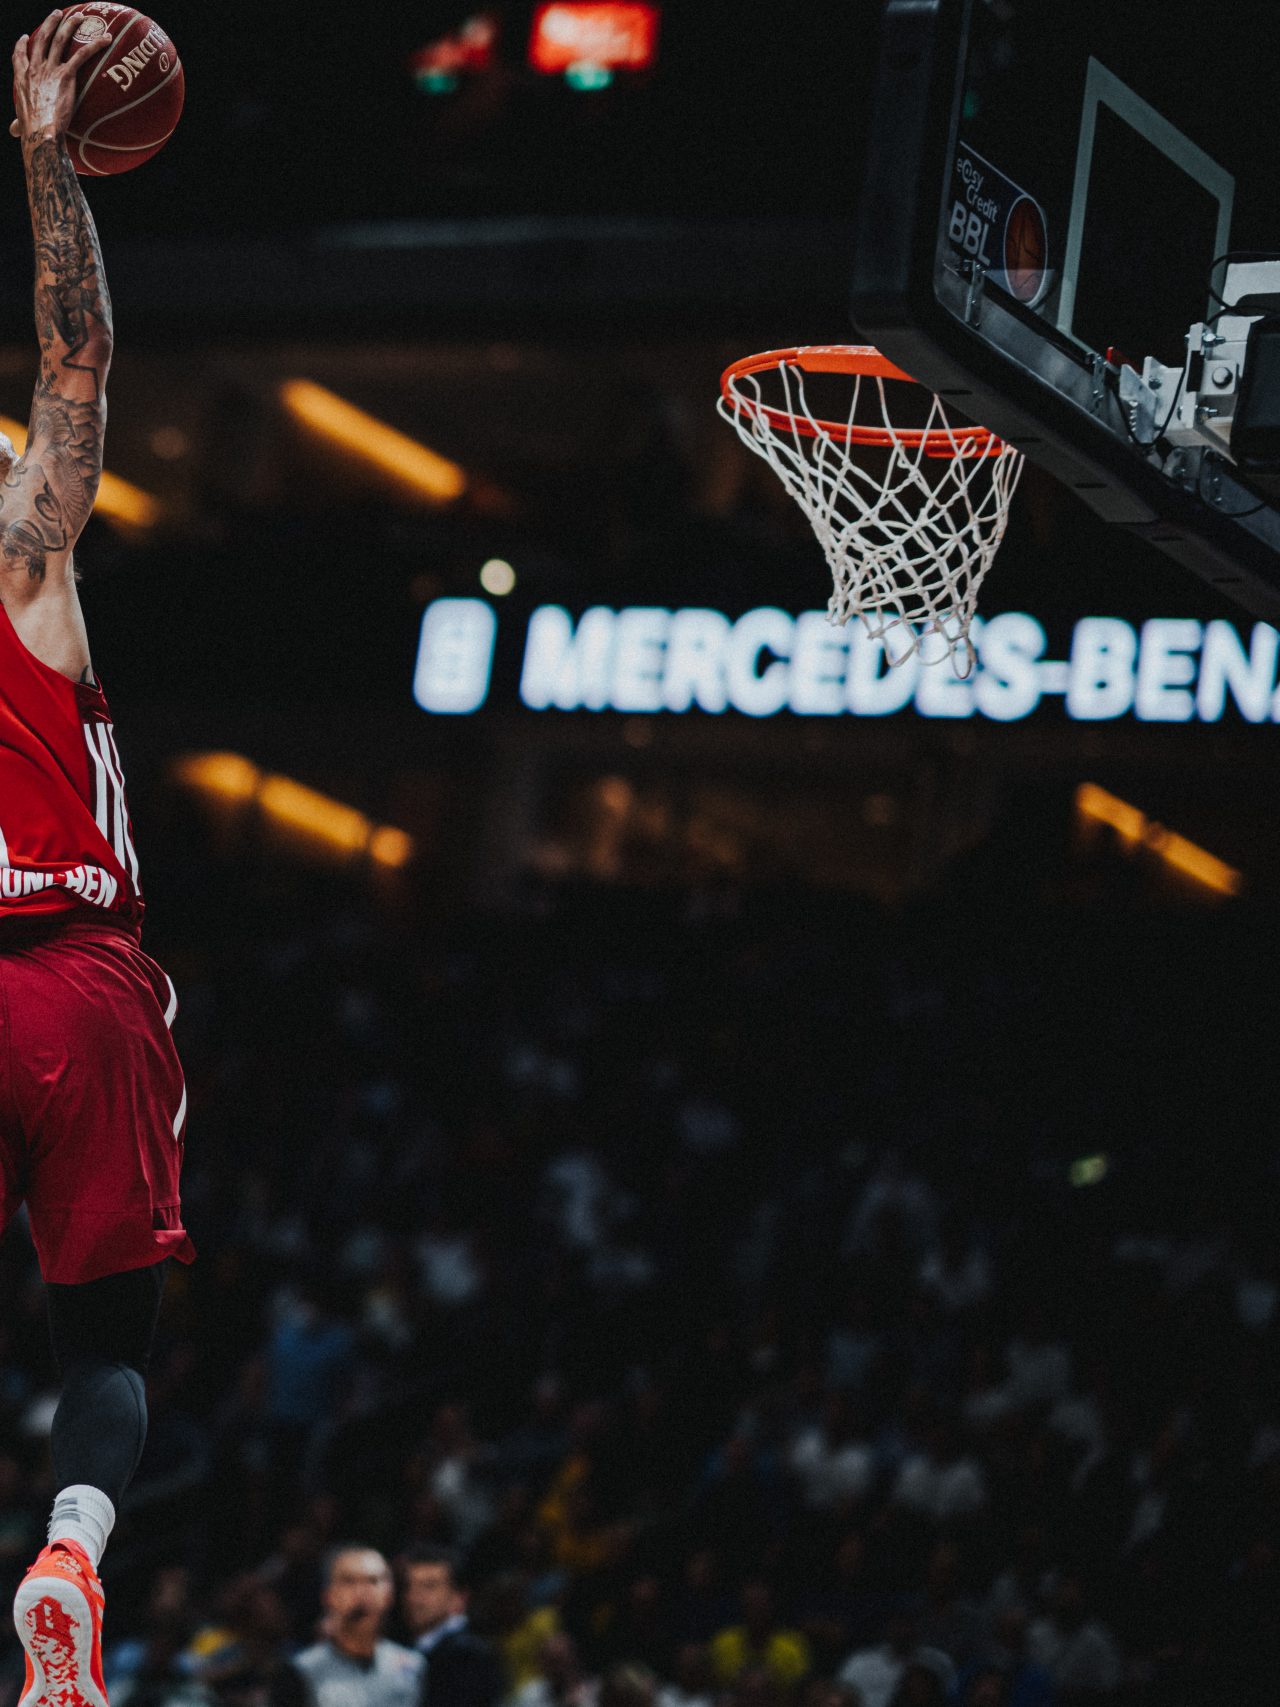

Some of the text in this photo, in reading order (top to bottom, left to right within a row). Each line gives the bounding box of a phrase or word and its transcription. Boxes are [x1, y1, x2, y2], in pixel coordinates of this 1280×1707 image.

[949, 200, 990, 266] BBL
[966, 184, 998, 223] Credit
[519, 604, 1280, 723] MERCEDES-BEN
